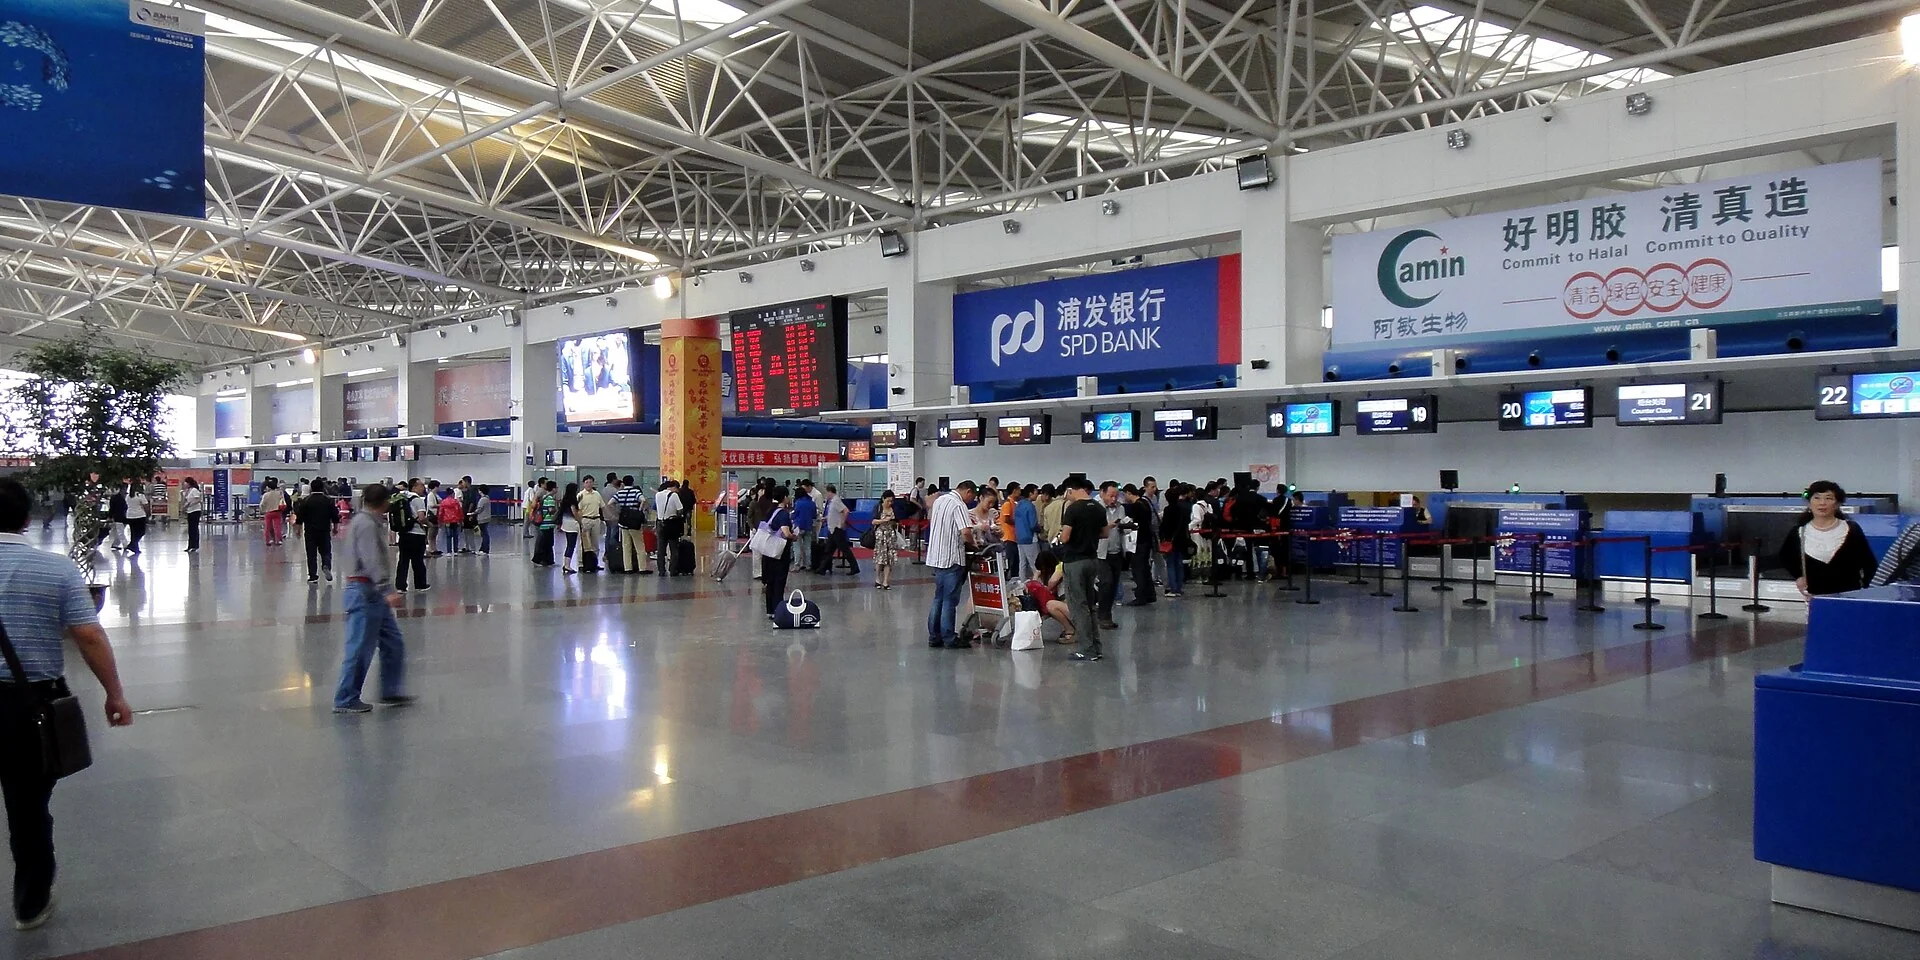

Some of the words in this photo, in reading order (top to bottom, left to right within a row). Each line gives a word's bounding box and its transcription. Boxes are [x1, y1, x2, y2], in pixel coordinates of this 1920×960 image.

[1502, 202, 1627, 252] 好明胶
[1659, 176, 1809, 234] 清真造
[1502, 253, 1561, 270] Commit
[1568, 251, 1584, 263] to
[1588, 244, 1628, 260] Halal
[1645, 235, 1713, 254] Commit
[1718, 232, 1735, 245] to
[1740, 223, 1810, 243] Quality
[1399, 253, 1465, 283] amin
[1568, 286, 1600, 306] 清洁
[1606, 282, 1641, 303] 绿色
[1648, 277, 1682, 297] 安全
[1691, 272, 1727, 294] 健康
[1057, 287, 1166, 331] 浦发银行
[1373, 311, 1468, 340] 阿敏生物
[1060, 333, 1098, 357] SPD
[1101, 326, 1162, 353] BANK
[1691, 393, 1711, 411] 21
[1821, 386, 1848, 406] 22
[1411, 406, 1427, 422] 19
[1502, 402, 1521, 418] 20
[1083, 420, 1095, 434] 16
[1195, 416, 1207, 430] 17
[1269, 412, 1283, 428] 18
[899, 428, 907, 440] 13
[939, 427, 948, 439] 14
[1033, 423, 1042, 436] 15
[841, 447, 846, 456] 7
